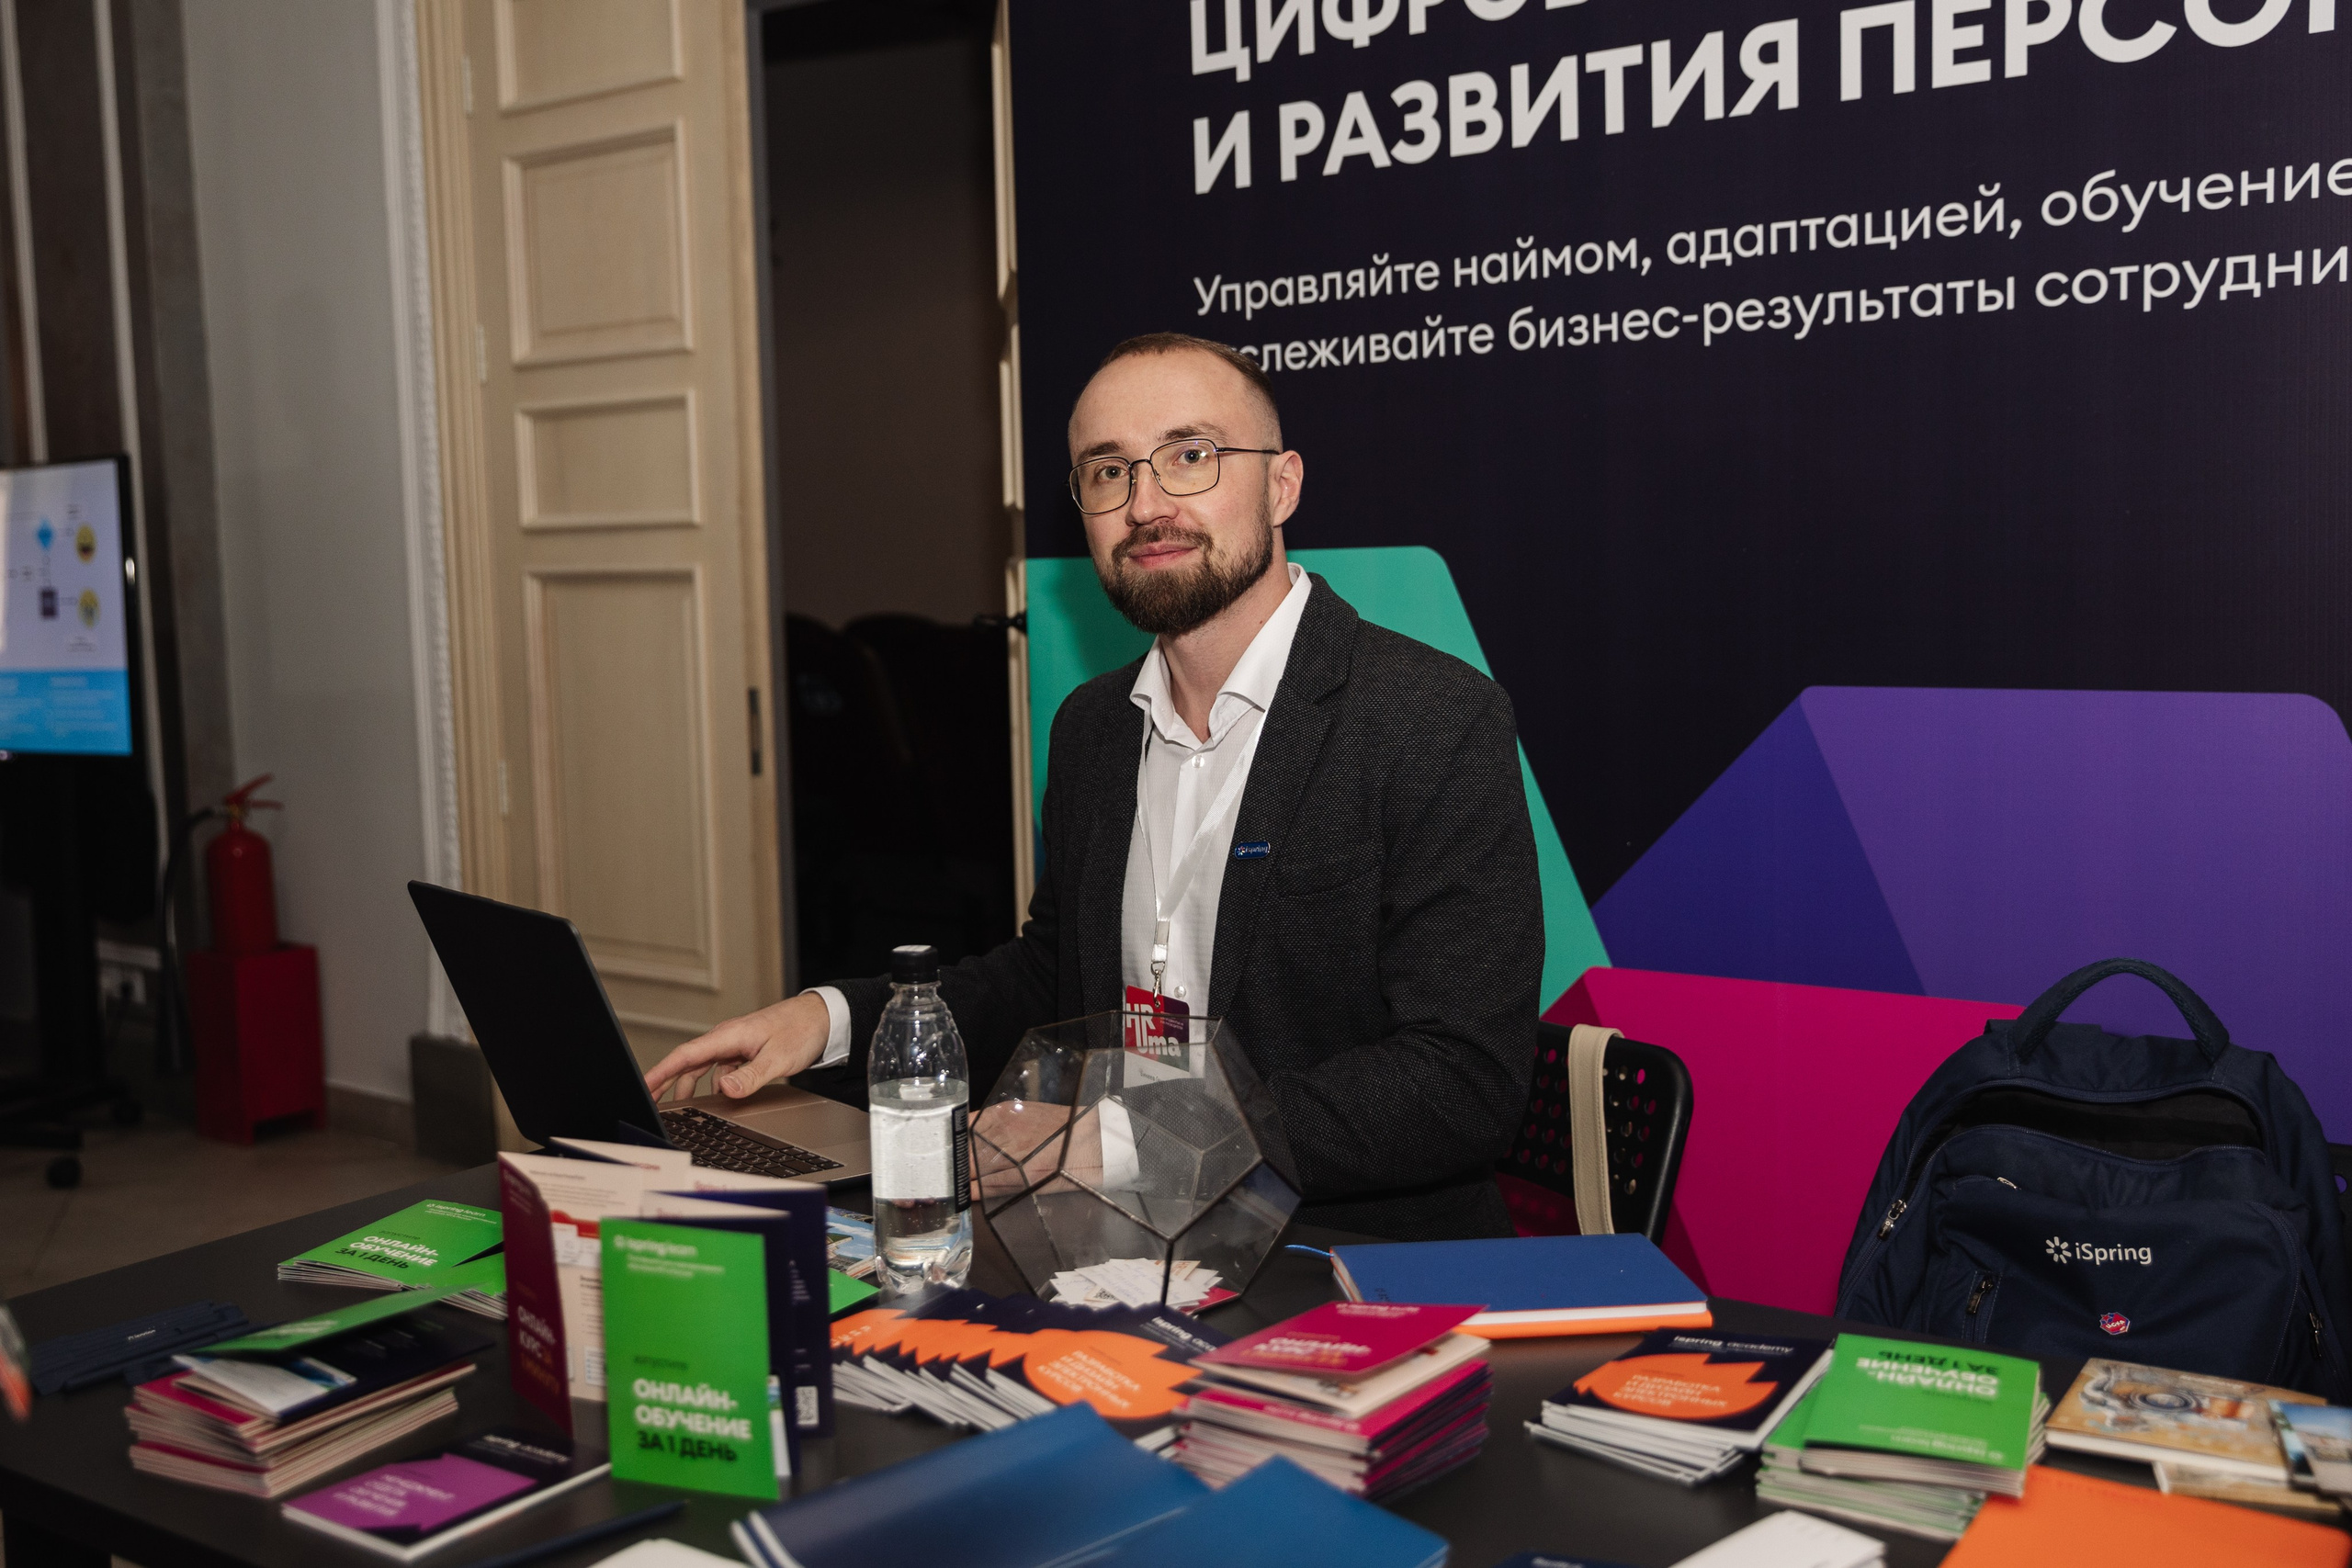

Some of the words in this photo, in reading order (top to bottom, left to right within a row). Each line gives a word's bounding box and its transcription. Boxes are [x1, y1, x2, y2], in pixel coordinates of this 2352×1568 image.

[1193, 109, 1252, 195] И
[1278, 18, 1800, 183] РАЗВИТИЯ
[1194, 254, 1441, 320] Управляйте
[1453, 235, 1653, 288] наймом,
[1666, 182, 2022, 266] адаптацией,
[2040, 157, 2352, 233] обучение
[1229, 315, 1495, 373] слеживайте
[1507, 276, 2016, 347] бизнес-результаты
[2034, 245, 2348, 313] сотрудни
[335, 1247, 358, 1258] ЗА
[365, 1254, 410, 1269] ДЕНЬ
[349, 1242, 438, 1267] ОБУЧЕНИЕ
[363, 1235, 439, 1257] ОНЛАЙН-
[2075, 1242, 2152, 1266] iSpring
[1726, 1341, 1793, 1355] academy
[1856, 1357, 1999, 1386] ОБУЧЕНИЕ
[1867, 1371, 1997, 1398] ОНЛАЙН-
[632, 1378, 739, 1411] ОНЛАЙН-
[635, 1404, 752, 1439] ОБУЧЕНИЕ
[638, 1429, 664, 1450] ЗА
[679, 1438, 738, 1461] ДЕНЬ
